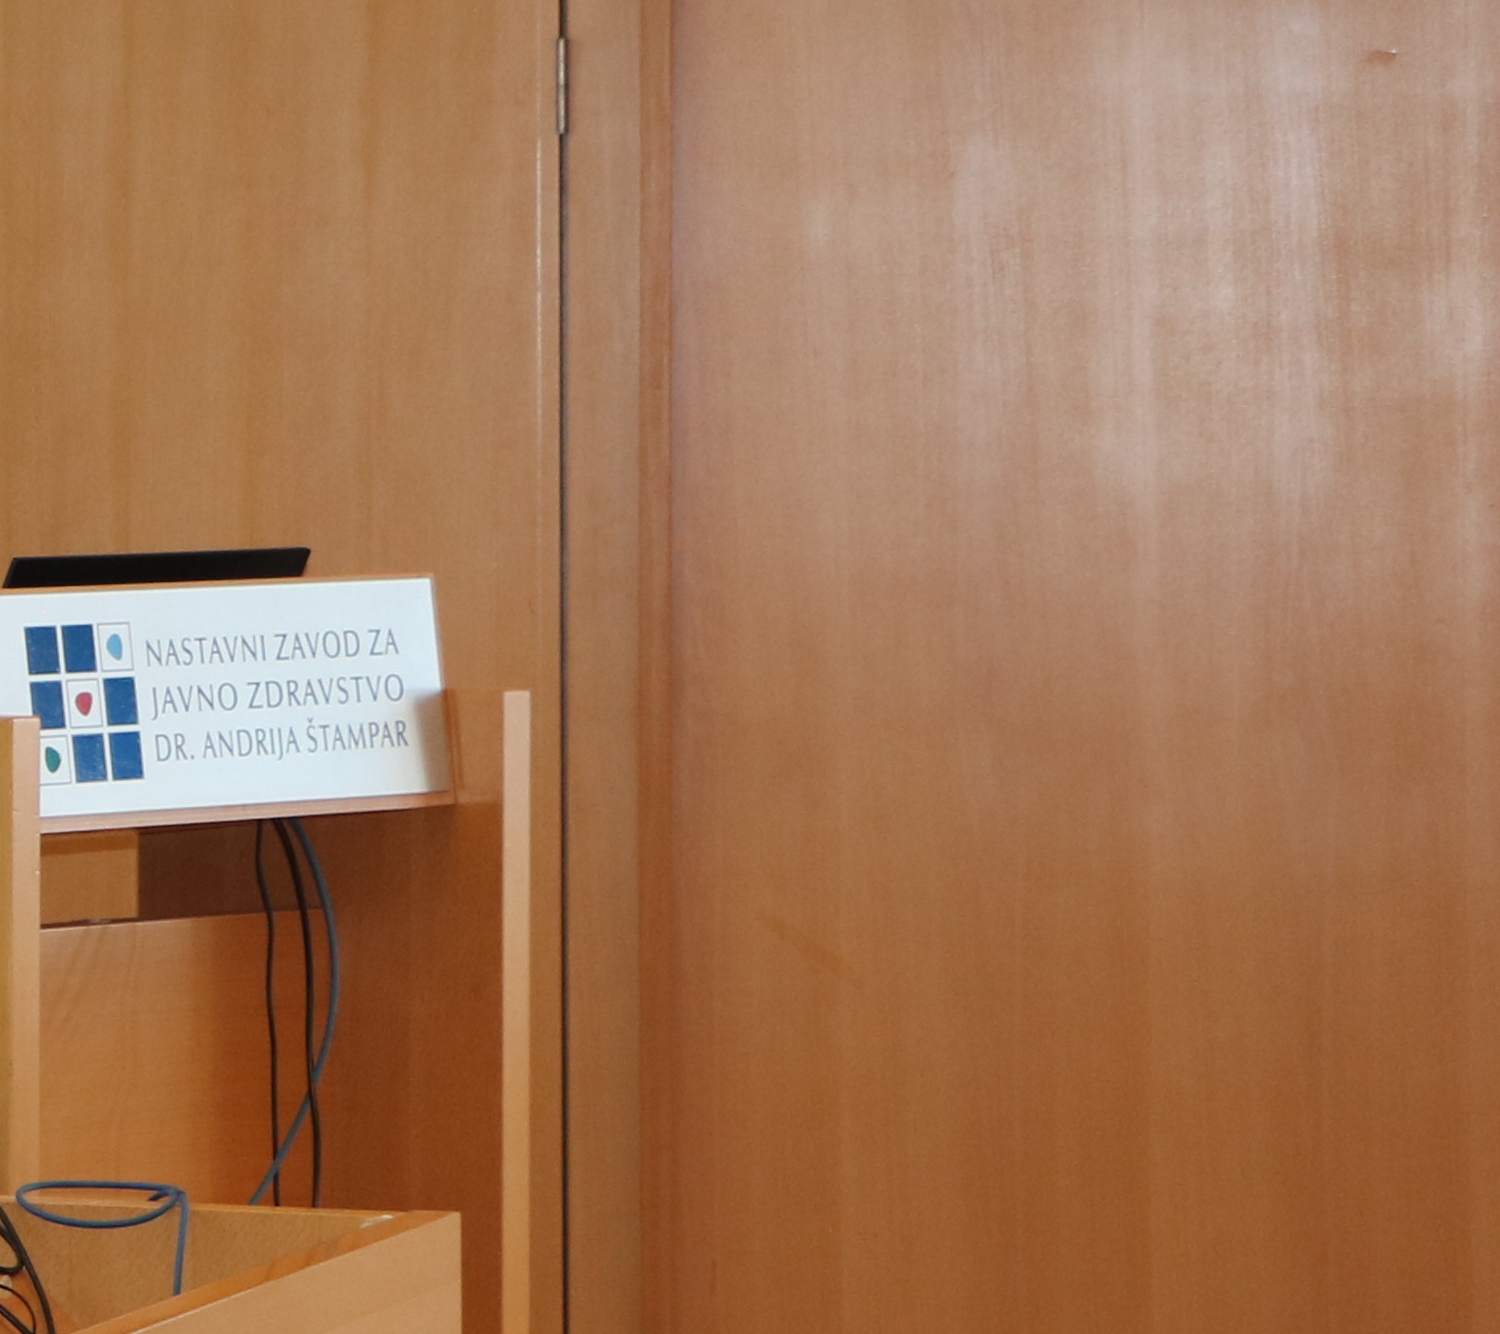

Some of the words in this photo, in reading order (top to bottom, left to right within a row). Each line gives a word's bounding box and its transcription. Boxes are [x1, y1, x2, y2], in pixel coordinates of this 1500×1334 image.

[145, 633, 267, 668] NASTAVNI
[273, 629, 361, 662] ZAVOD
[367, 627, 400, 657] ZA
[150, 681, 239, 721] JAVNO
[246, 673, 405, 710] ZDRAVSTVO
[153, 732, 196, 763] DR.
[201, 725, 301, 761] ANDRIJA
[305, 716, 410, 754] ŠTAMPAR
